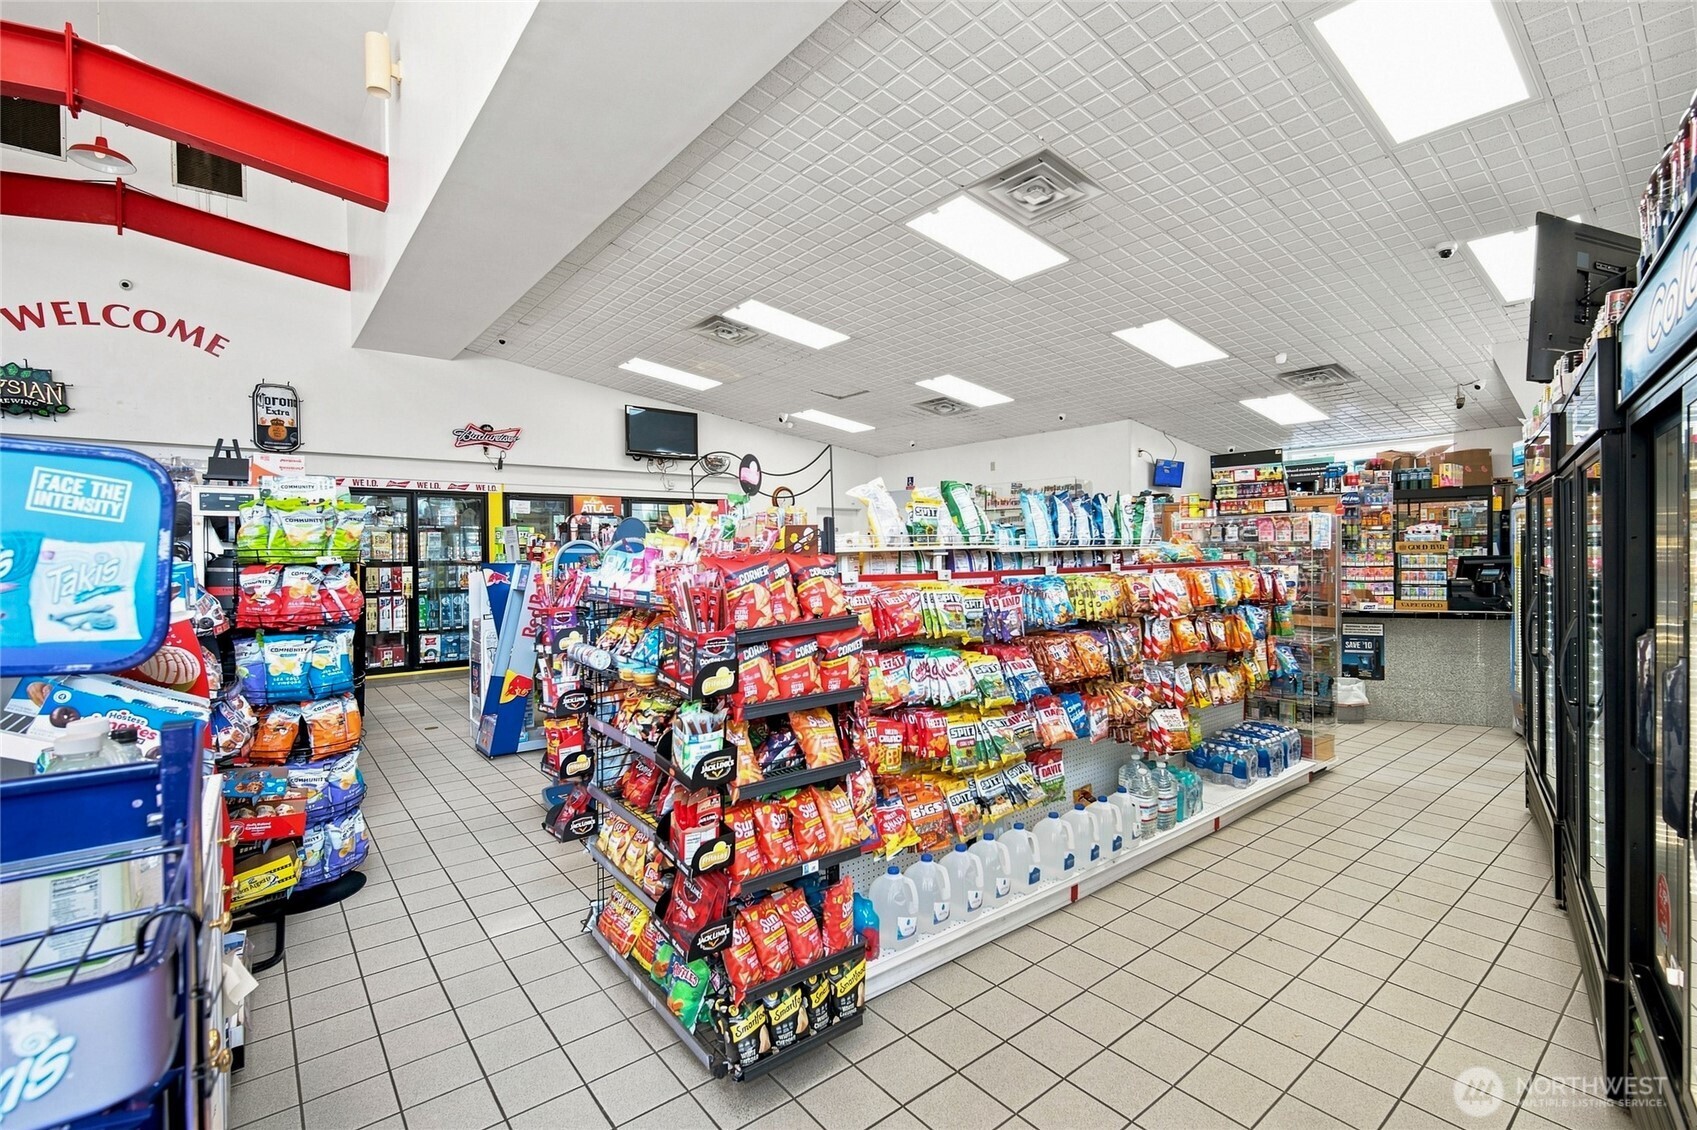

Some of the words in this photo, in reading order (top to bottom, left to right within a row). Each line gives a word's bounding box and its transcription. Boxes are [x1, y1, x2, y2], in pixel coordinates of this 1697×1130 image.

[1, 301, 230, 357] WELCOME
[266, 407, 290, 416] Extra
[453, 428, 520, 443] Budweiser
[37, 473, 85, 495] FACE
[91, 481, 125, 501] THE
[352, 479, 365, 487] WE
[416, 481, 428, 489] WE
[34, 490, 123, 517] INTENSITY
[581, 504, 615, 513] ATLAS
[47, 558, 121, 605] Takis
[1345, 641, 1361, 649] SAVE
[109, 712, 146, 726] Hostess
[701, 764, 718, 774] JACK
[791, 905, 811, 924] Sun
[760, 913, 779, 934] Sun
[697, 935, 713, 946] JACK
